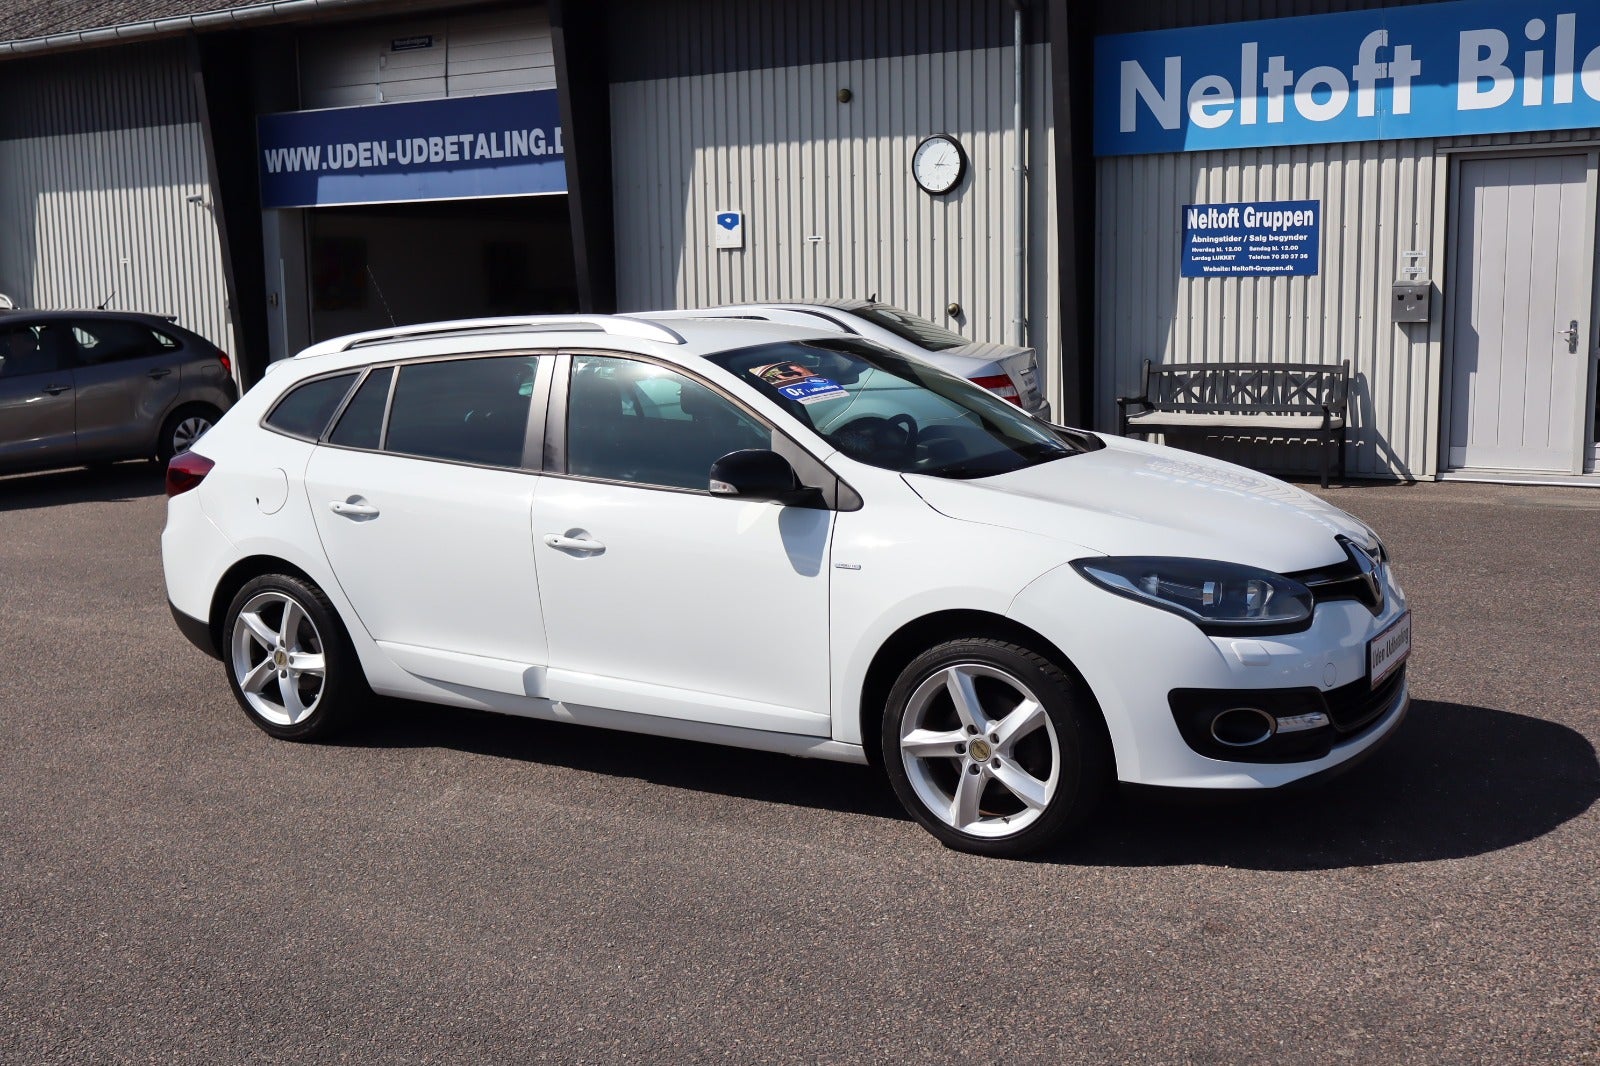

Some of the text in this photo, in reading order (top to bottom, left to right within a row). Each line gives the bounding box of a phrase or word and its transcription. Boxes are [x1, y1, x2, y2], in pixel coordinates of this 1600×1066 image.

[1120, 30, 1421, 133] Neltoft
[1187, 206, 1314, 232] Neltoft Gruppen
[1249, 234, 1268, 243] Salg
[1268, 233, 1308, 243] begynder
